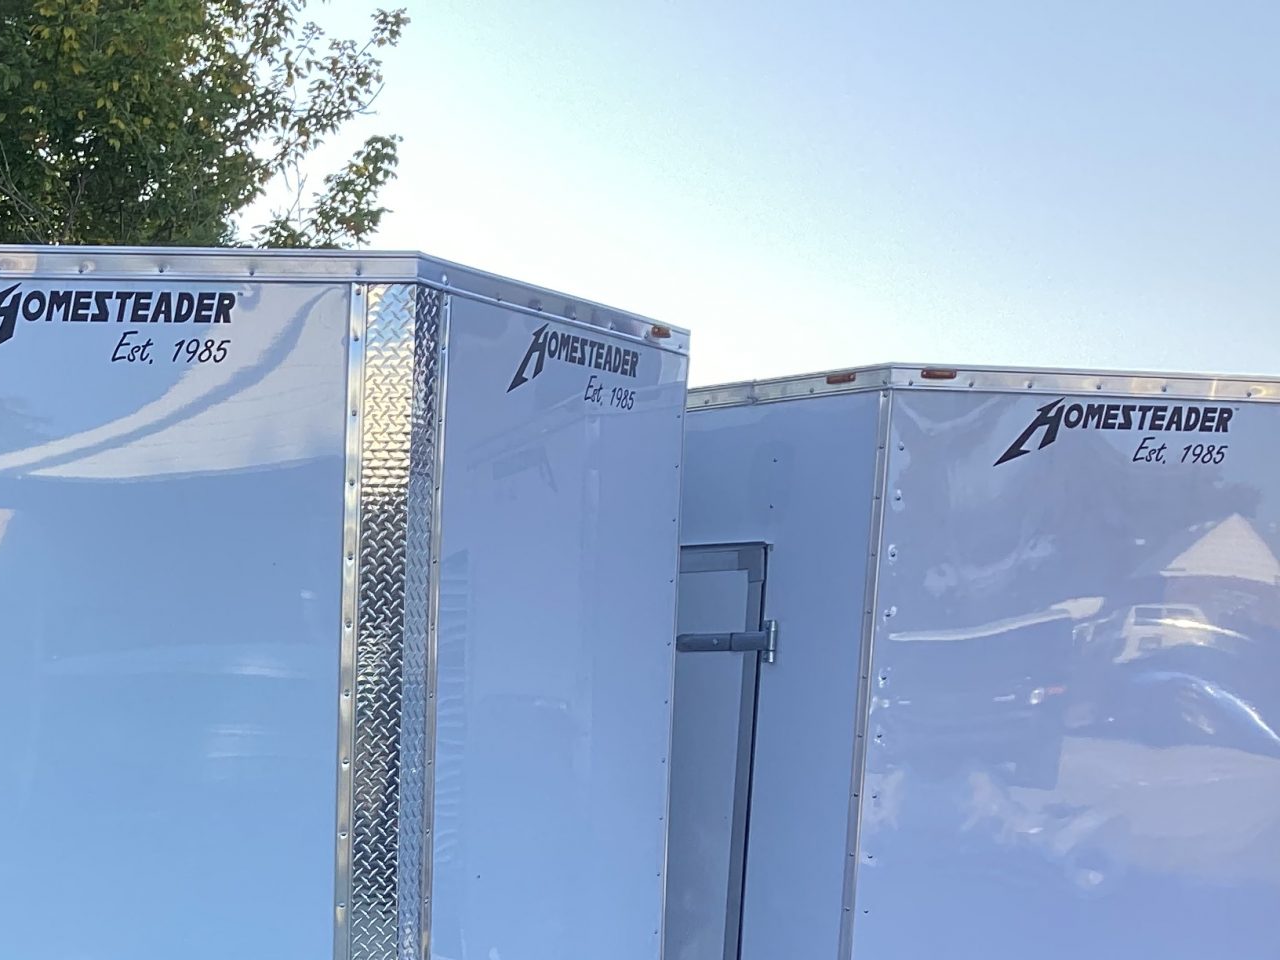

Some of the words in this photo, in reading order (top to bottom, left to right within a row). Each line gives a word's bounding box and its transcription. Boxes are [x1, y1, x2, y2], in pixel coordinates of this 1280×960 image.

[111, 330, 154, 365] Est.
[172, 338, 232, 364] 1985
[506, 322, 640, 394] HOMESTEADER
[584, 375, 604, 407] Est.
[610, 387, 637, 411] 1985
[993, 396, 1234, 467] HOMESTEADER
[1132, 436, 1167, 465] Est.
[1180, 444, 1229, 465] 1985
